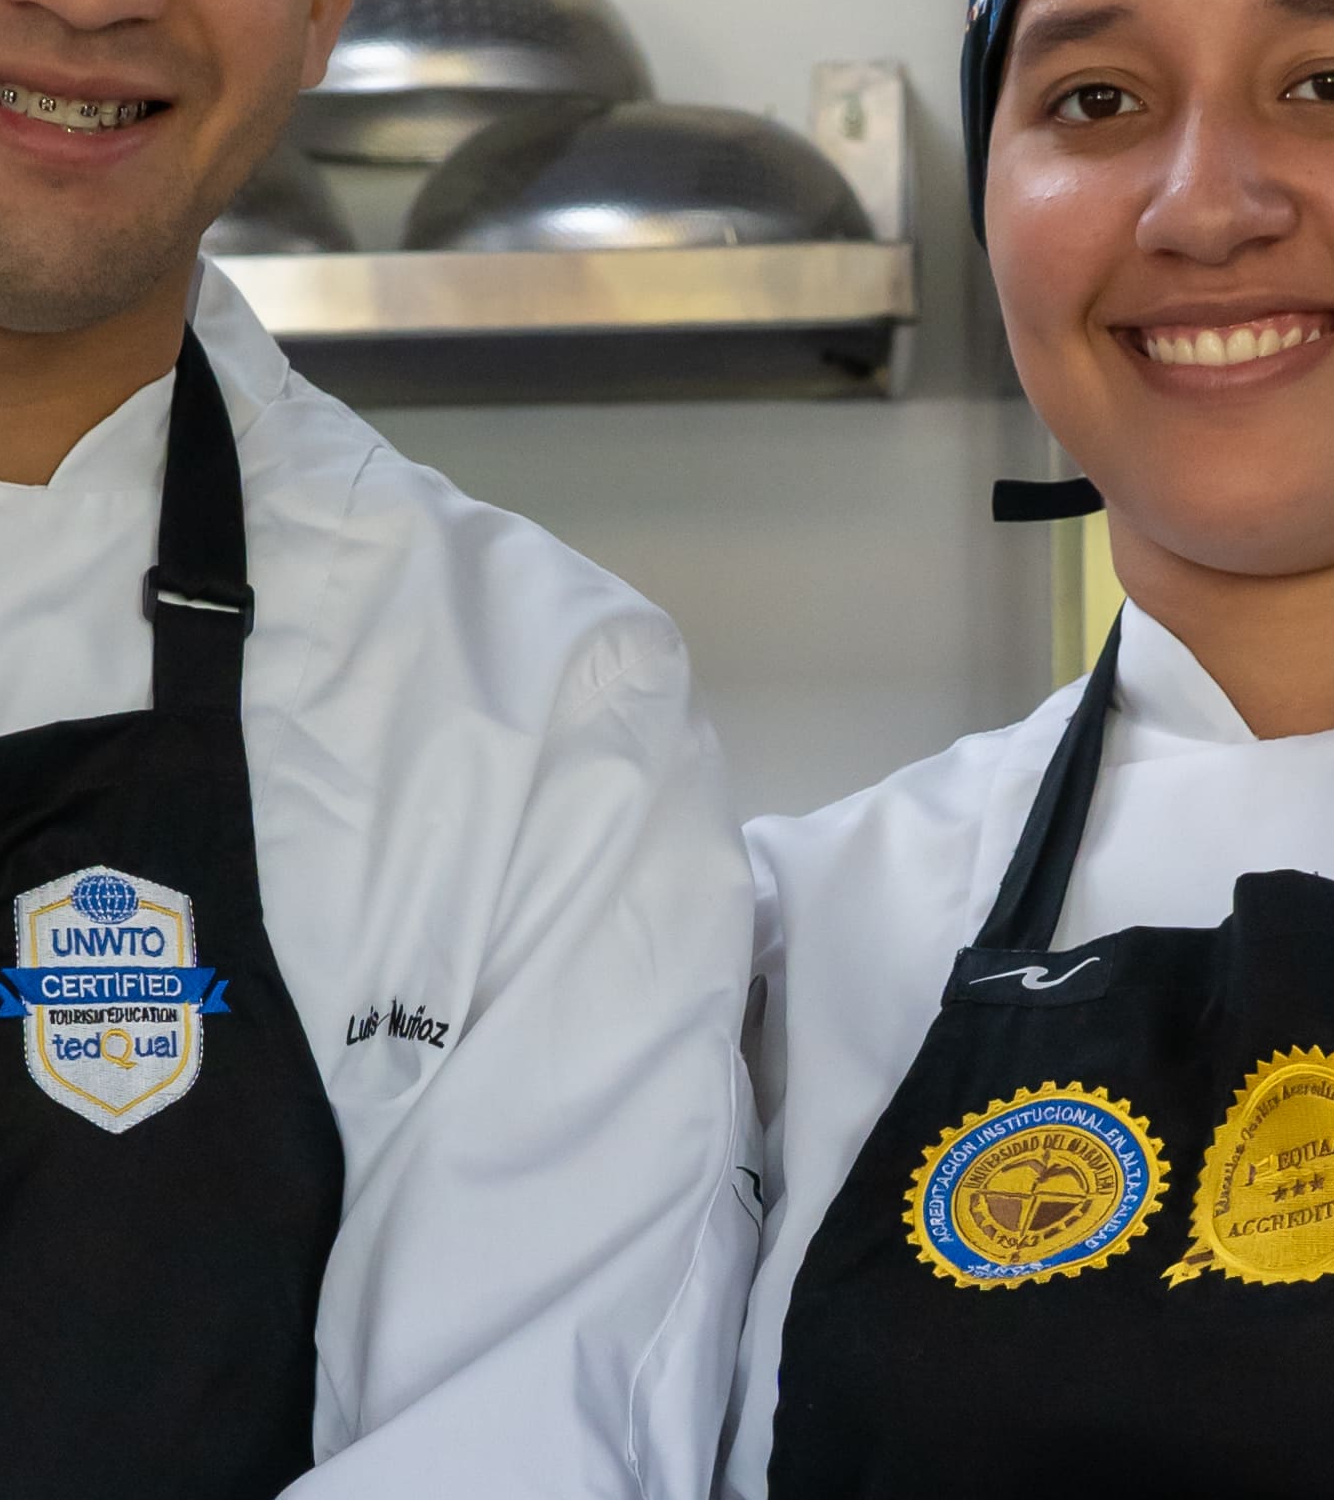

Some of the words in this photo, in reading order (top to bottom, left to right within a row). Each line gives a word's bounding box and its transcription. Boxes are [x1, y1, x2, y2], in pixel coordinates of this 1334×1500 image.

[51, 926, 166, 957] UNWTO
[41, 972, 182, 998] CERTIFIED
[52, 1027, 178, 1069] tedQual
[1043, 1133, 1066, 1150] DEL
[927, 1140, 978, 1244] ACREDITACIÓN
[975, 1105, 1105, 1148] INSTITUCIONAL
[1105, 1128, 1128, 1152] EN
[1120, 1150, 1142, 1198] ALTA
